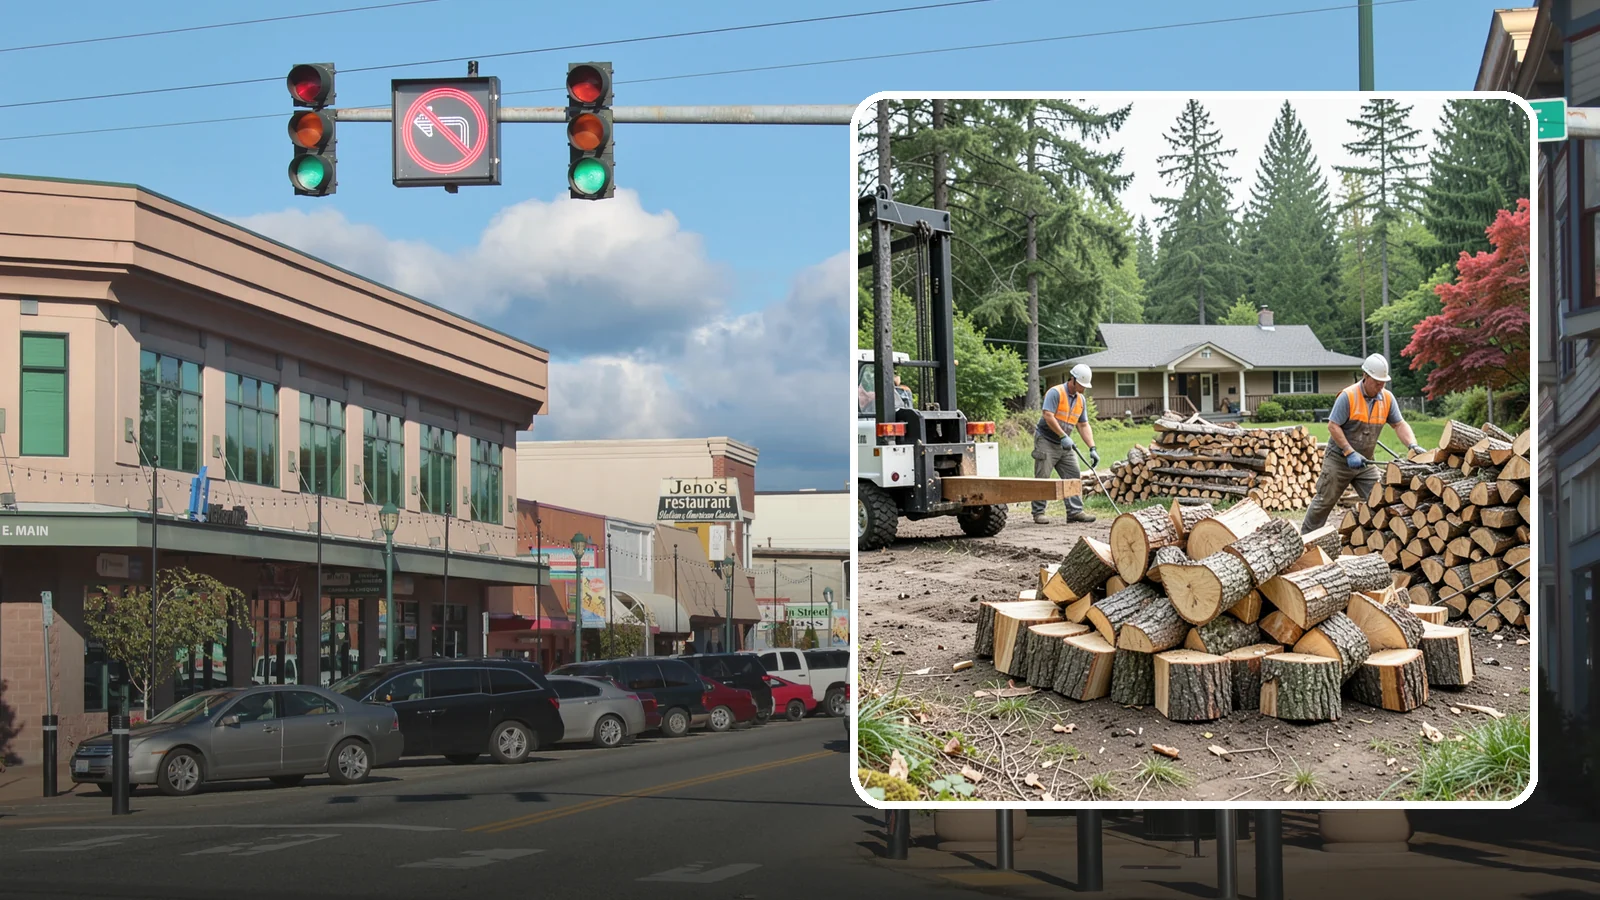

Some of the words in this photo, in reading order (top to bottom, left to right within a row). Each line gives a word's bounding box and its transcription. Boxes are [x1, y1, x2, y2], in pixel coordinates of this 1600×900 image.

[670, 480, 727, 494] Jeno's
[665, 496, 731, 508] restaurant
[659, 510, 681, 519] Italian
[686, 510, 714, 519] American
[715, 510, 737, 519] Cuisine
[2, 525, 13, 536] E.
[15, 525, 49, 536] MAIN
[797, 608, 828, 616] Street
